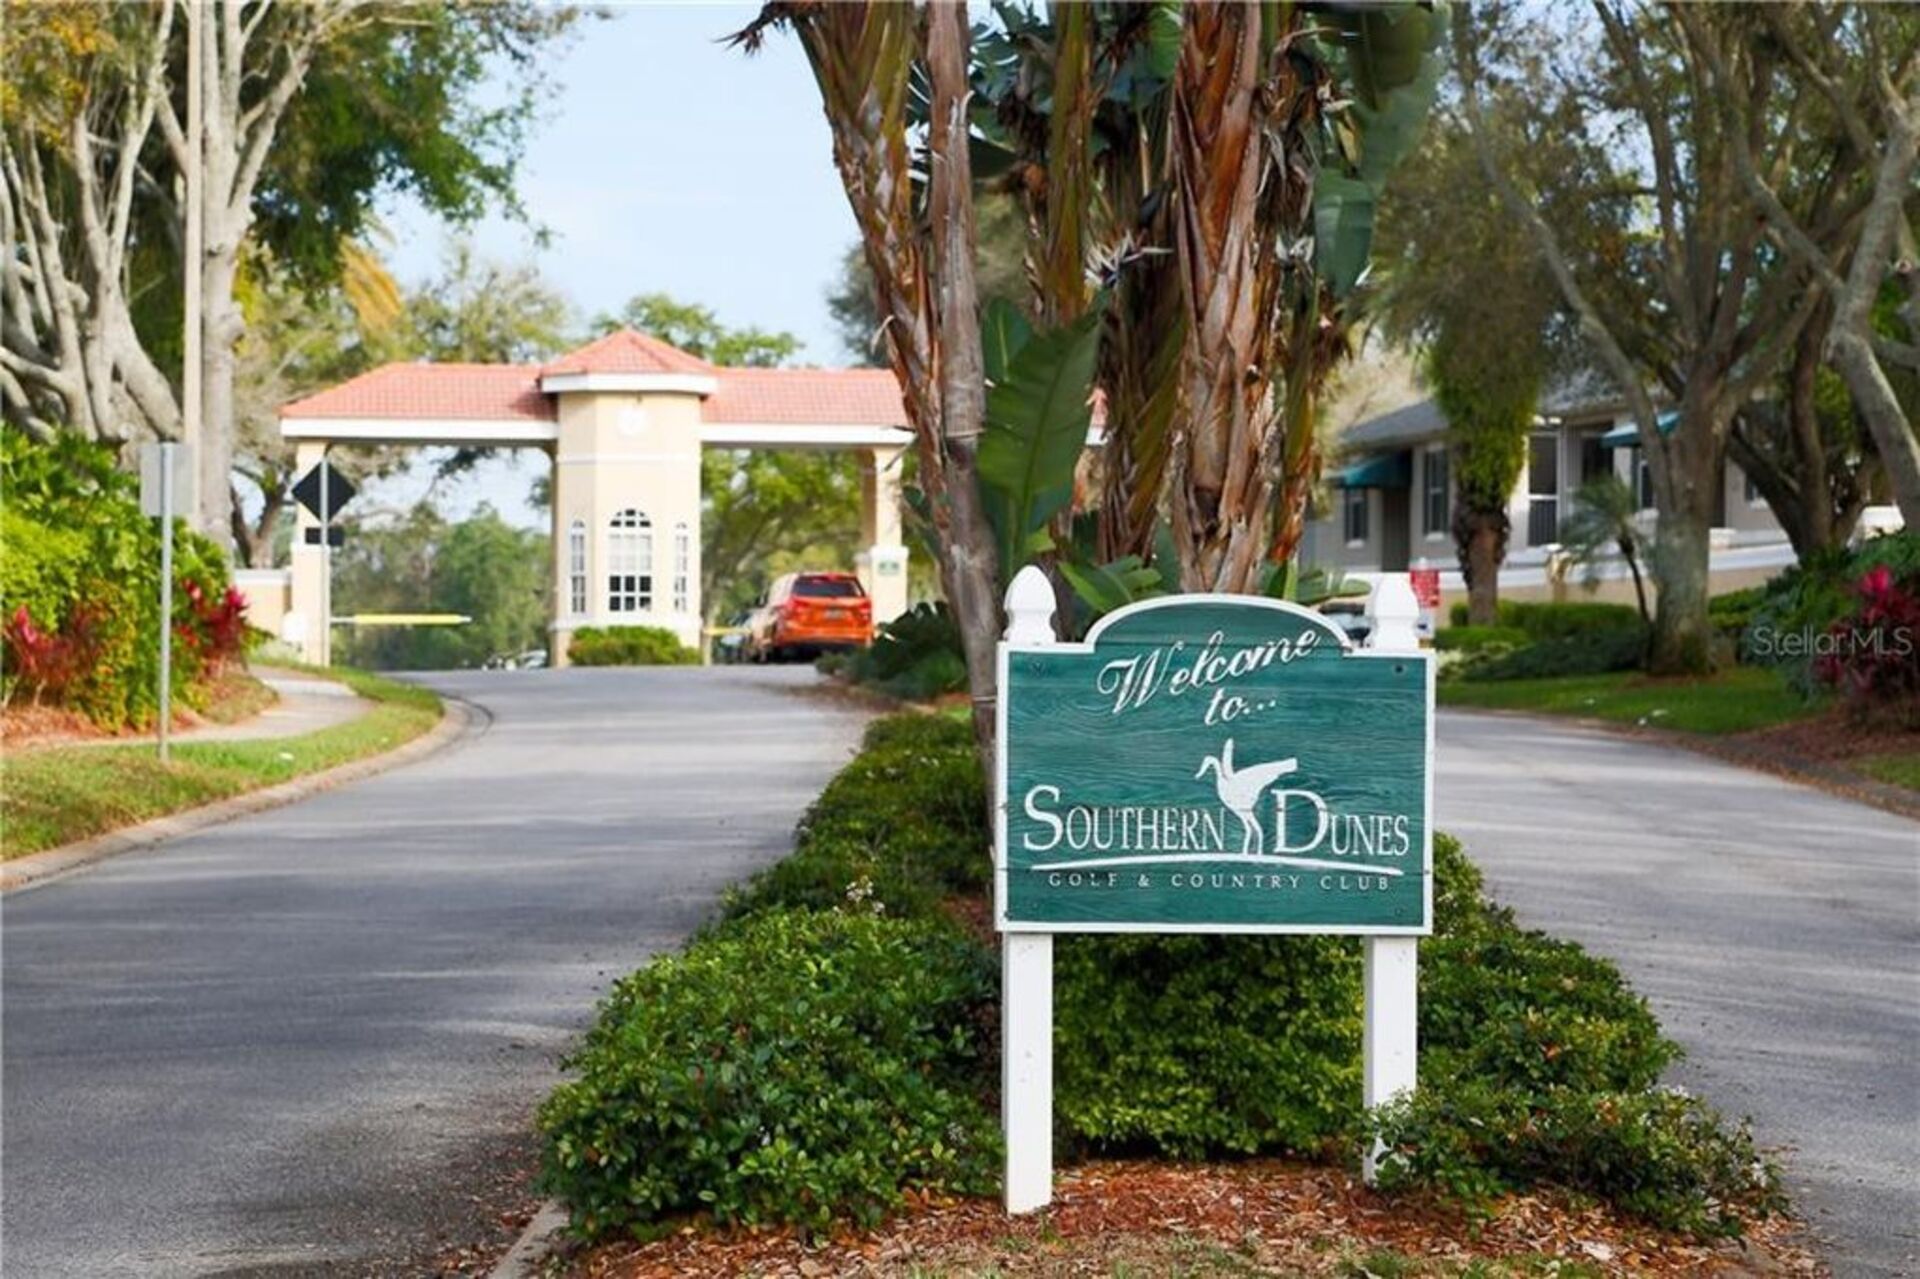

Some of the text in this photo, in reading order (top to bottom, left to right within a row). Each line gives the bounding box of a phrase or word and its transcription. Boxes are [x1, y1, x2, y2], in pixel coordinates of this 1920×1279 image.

[1097, 629, 1320, 714] Welcome
[1203, 687, 1278, 727] to...
[1048, 872, 1389, 891] GOLF & COUNTRY CLUB
